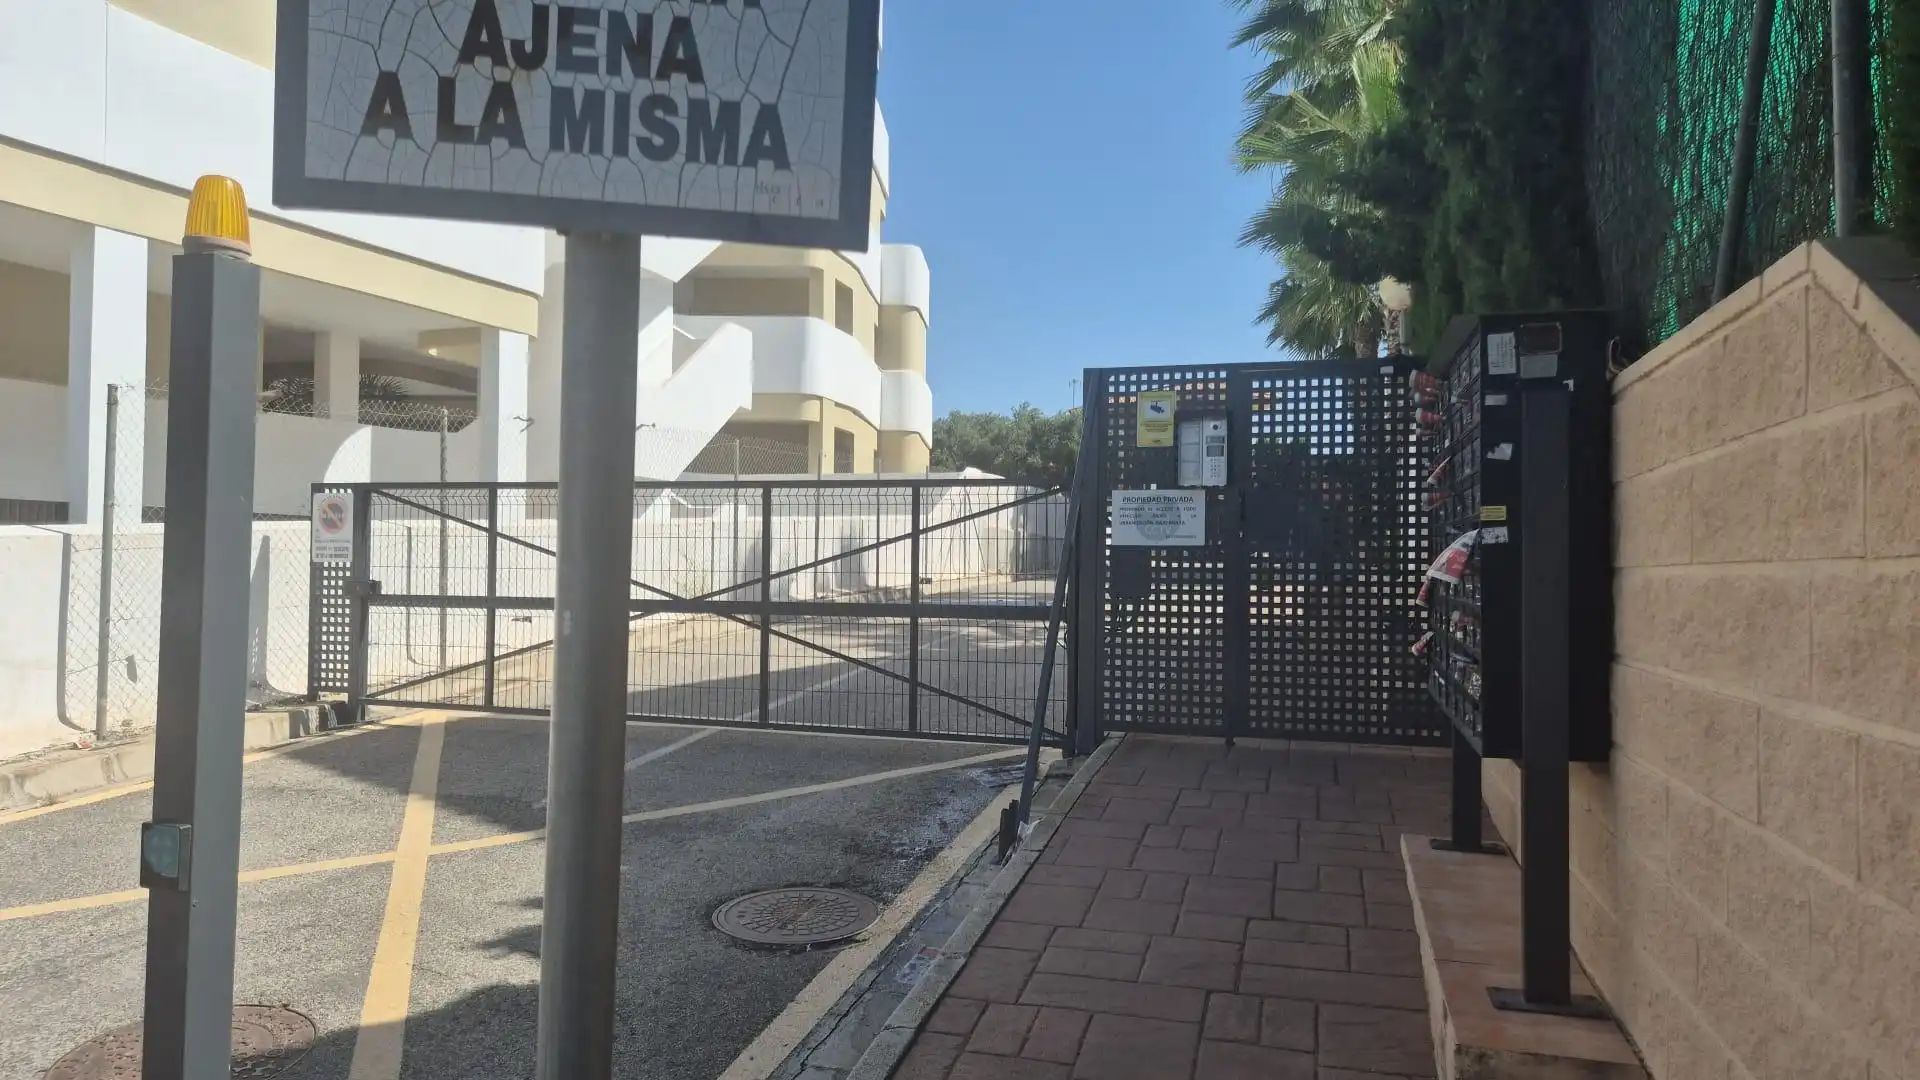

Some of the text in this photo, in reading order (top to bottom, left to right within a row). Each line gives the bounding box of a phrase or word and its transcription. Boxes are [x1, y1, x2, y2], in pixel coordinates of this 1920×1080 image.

[458, 0, 707, 84] AJENA
[359, 71, 793, 172] A LA MISMA
